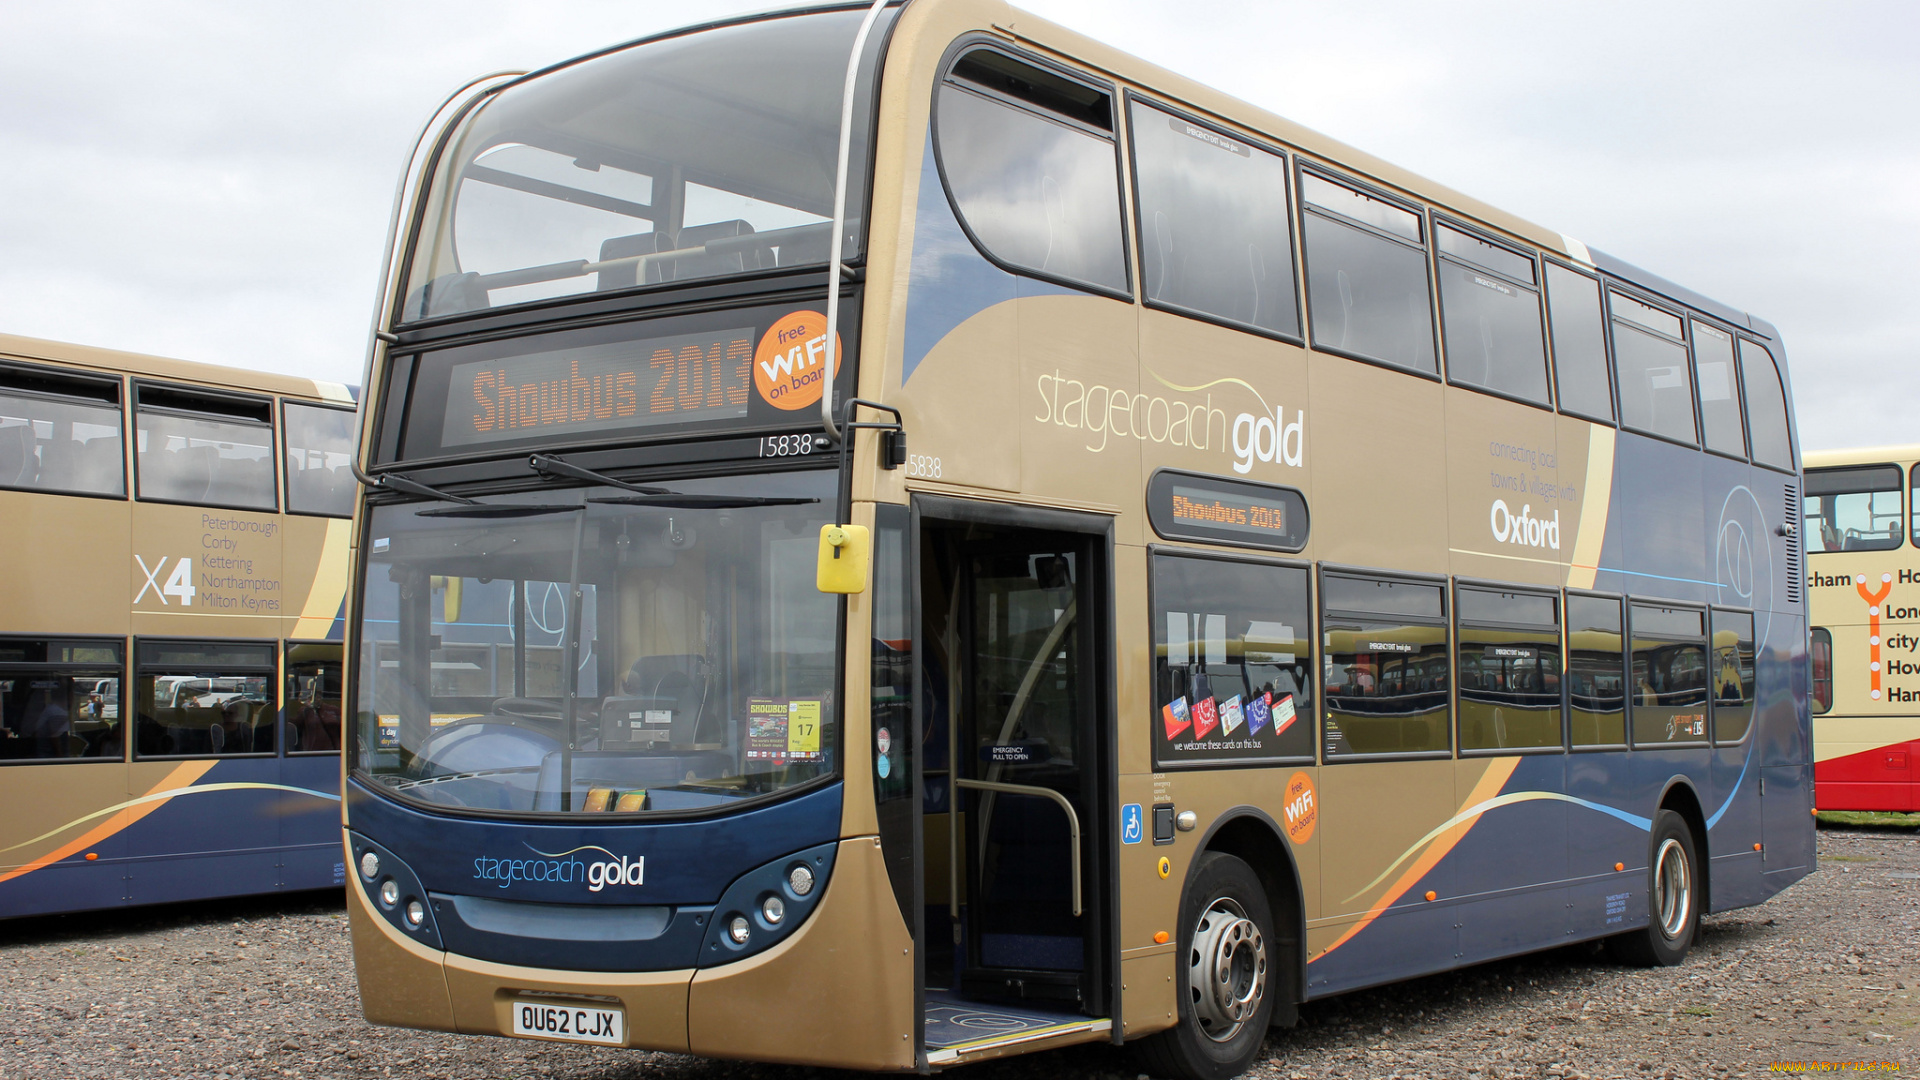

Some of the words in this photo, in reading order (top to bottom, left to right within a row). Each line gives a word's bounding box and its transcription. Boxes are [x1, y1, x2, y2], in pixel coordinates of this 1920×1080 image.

[777, 325, 806, 345] free
[473, 360, 637, 432] Showbus
[650, 339, 751, 413] 2013
[770, 383, 788, 399] on
[791, 367, 824, 390] boar
[1035, 368, 1228, 453] stagecoach
[1232, 405, 1304, 474] gold
[759, 433, 812, 458] 15838
[1489, 441, 1537, 470] connecting
[1538, 447, 1557, 468] local
[1490, 470, 1518, 491] towns
[1520, 473, 1527, 493] &
[1529, 475, 1557, 503] villages
[1559, 481, 1577, 501] with
[1173, 495, 1246, 525] Showbus
[1250, 506, 1281, 529] 2013
[1490, 499, 1560, 550] Oxford
[202, 514, 278, 537] Peterborough
[202, 533, 238, 553] Corby
[202, 553, 253, 575] Kettering
[133, 554, 196, 606] X4
[202, 573, 280, 593] Northampton
[202, 592, 237, 608] Milton
[241, 595, 280, 613] Keynes
[1886, 604, 1920, 619] Lon
[1887, 633, 1919, 653] city
[386, 728, 397, 737] day
[797, 724, 813, 736] 17
[1174, 743, 1183, 751] we
[1184, 740, 1207, 750] welcome
[1207, 740, 1221, 750] these
[1222, 739, 1235, 749] cards
[1236, 741, 1243, 749] on
[1243, 739, 1252, 749] this
[1252, 739, 1262, 748] bus
[1291, 782, 1303, 795] free
[1285, 789, 1313, 823] WiFi
[1291, 825, 1298, 836] on
[1298, 809, 1315, 830] board
[473, 855, 585, 889] stagecoach
[588, 855, 645, 892] gold
[522, 1006, 570, 1033] OU62
[575, 1011, 614, 1038] CJX
